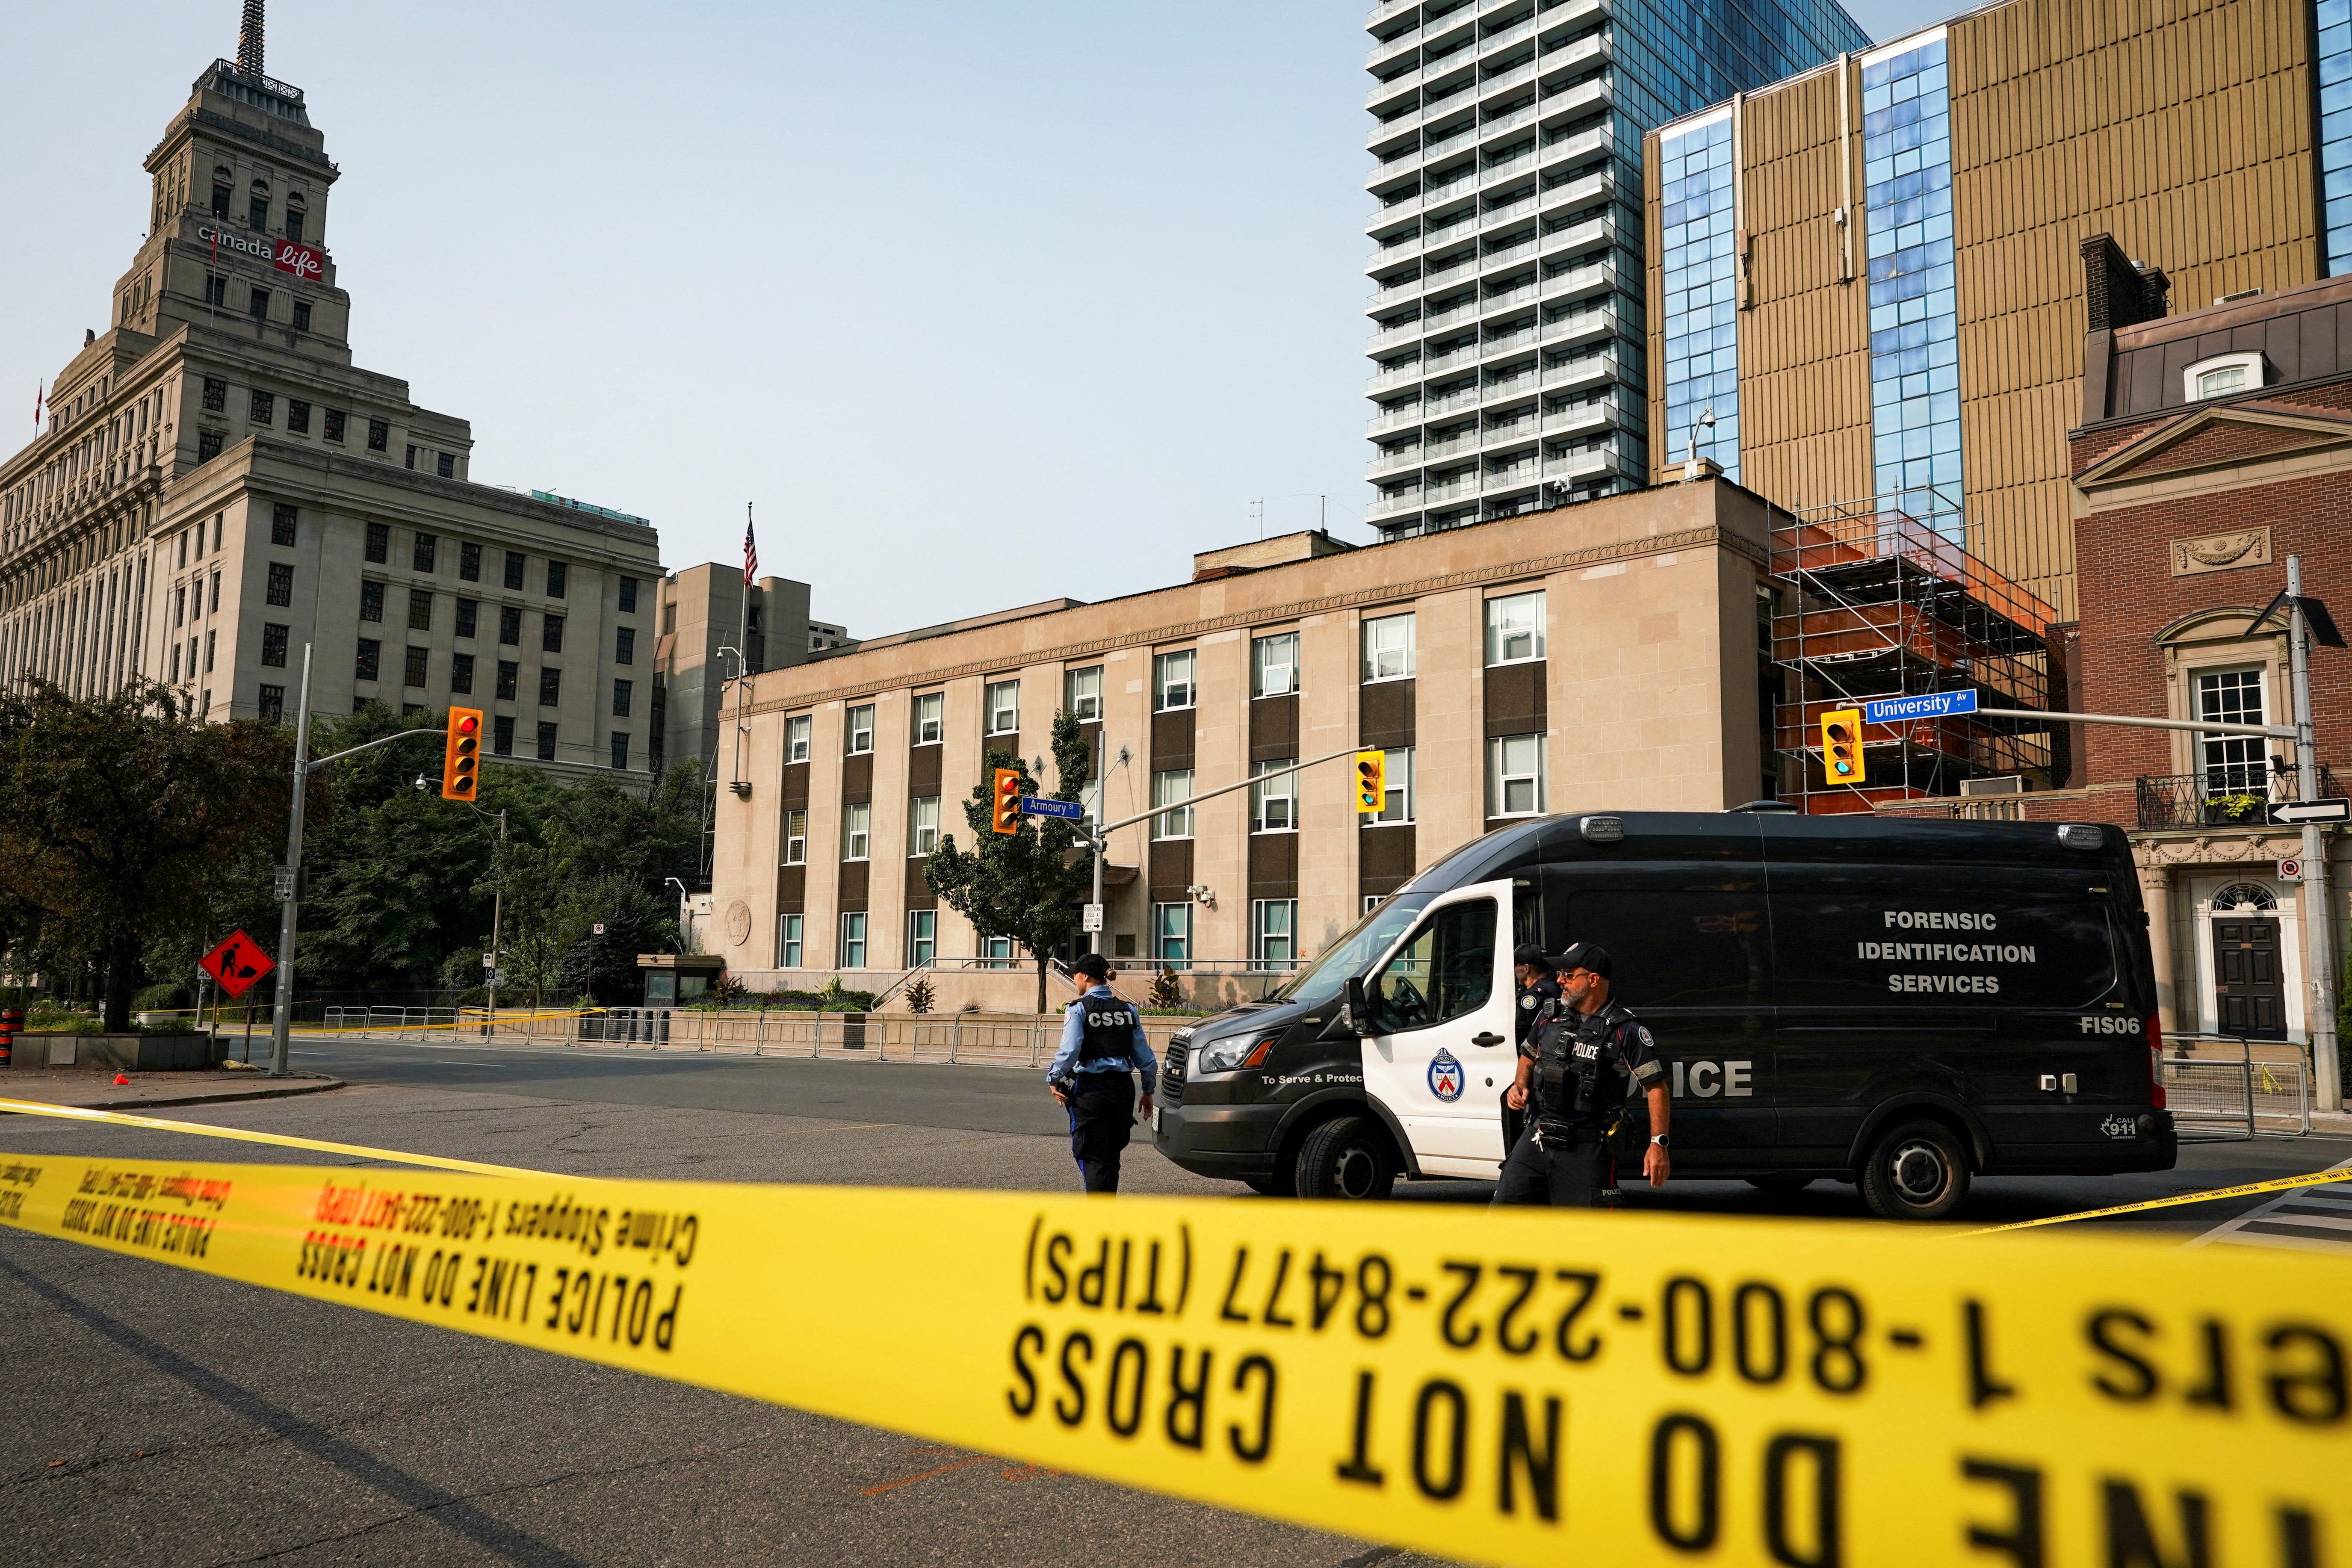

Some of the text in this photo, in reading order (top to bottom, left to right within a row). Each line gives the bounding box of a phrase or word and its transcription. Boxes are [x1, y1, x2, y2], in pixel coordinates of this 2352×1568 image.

[198, 227, 322, 277] canada life
[1874, 693, 1967, 717] University Av
[1030, 799, 1066, 815] Armoury
[1884, 911, 1996, 930] FORENSIC
[1858, 942, 2036, 963] IDENTIFICATION
[1889, 974, 1999, 993] SERVICES
[1088, 1011, 1133, 1027] CSST
[2081, 1017, 2140, 1034] FIS06
[1572, 1042, 1599, 1060] POLICE
[1262, 1074, 1363, 1084] To Serve & Protec
[1627, 1061, 1752, 1098] ICE
[2110, 1123, 2136, 1135] 9-1-1
[505, 1192, 609, 1257] Stoppers
[615, 1206, 700, 1268] Crime
[1025, 1216, 1194, 1316] (TIPS)
[297, 1231, 685, 1352] POLICE LINE DO NOT CROSS
[1008, 1323, 1278, 1464] CROSS
[1337, 1370, 1563, 1522] NOT
[1647, 1411, 1844, 1568] DO
